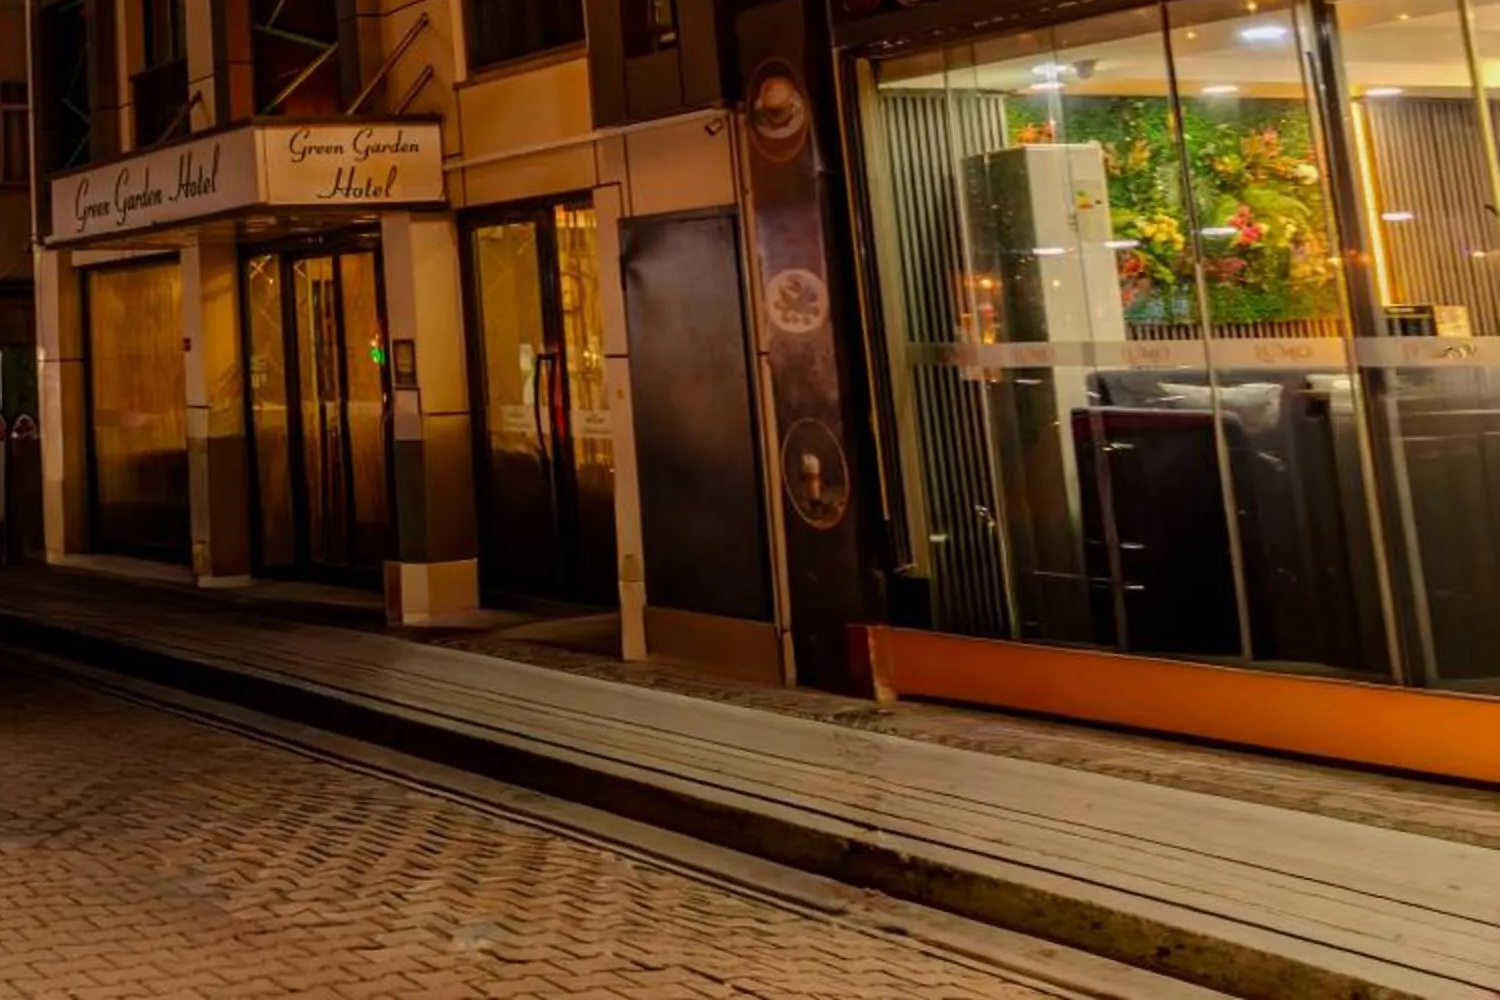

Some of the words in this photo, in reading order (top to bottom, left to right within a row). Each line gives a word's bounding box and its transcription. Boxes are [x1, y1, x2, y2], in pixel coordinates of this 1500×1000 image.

[288, 126, 345, 163] Green
[352, 126, 420, 162] Garden
[74, 177, 111, 233] Green
[114, 166, 163, 226] Garden
[168, 142, 221, 201] Hotel
[316, 164, 398, 200] Hotel
